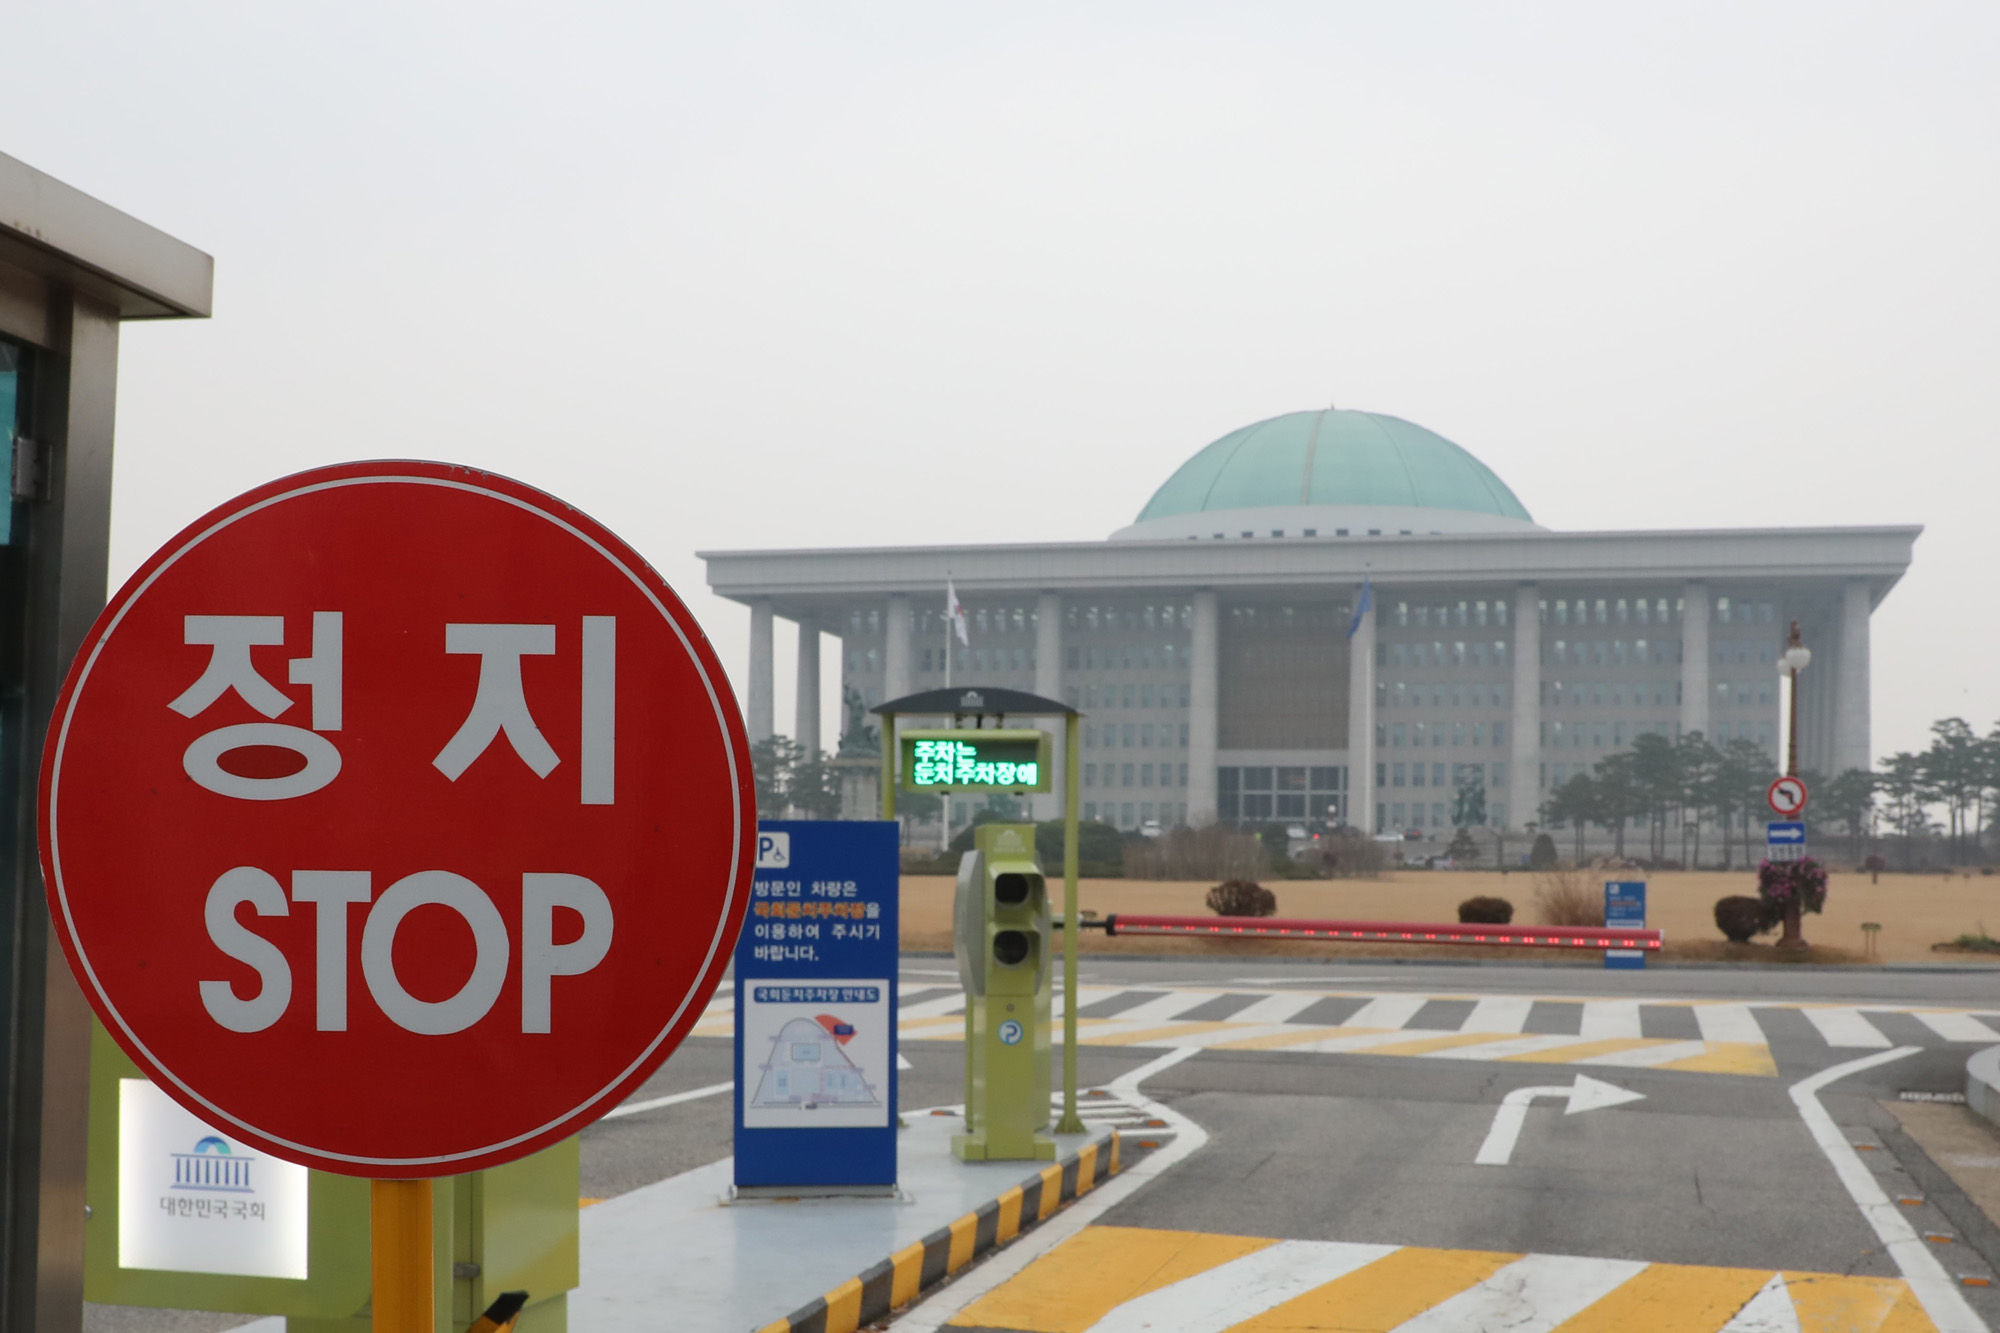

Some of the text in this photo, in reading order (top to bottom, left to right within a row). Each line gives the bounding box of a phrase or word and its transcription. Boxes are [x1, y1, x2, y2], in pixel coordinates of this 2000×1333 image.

[167, 611, 616, 805] 정지
[914, 740, 977, 763] 주차는
[759, 837, 773, 861] P
[755, 880, 857, 897] 방문인 차량은
[755, 923, 880, 940] 이용하여 주시기
[199, 866, 614, 1036] STOP
[754, 945, 820, 961] 바랍니다.
[160, 1197, 266, 1221] 대한민국국회
